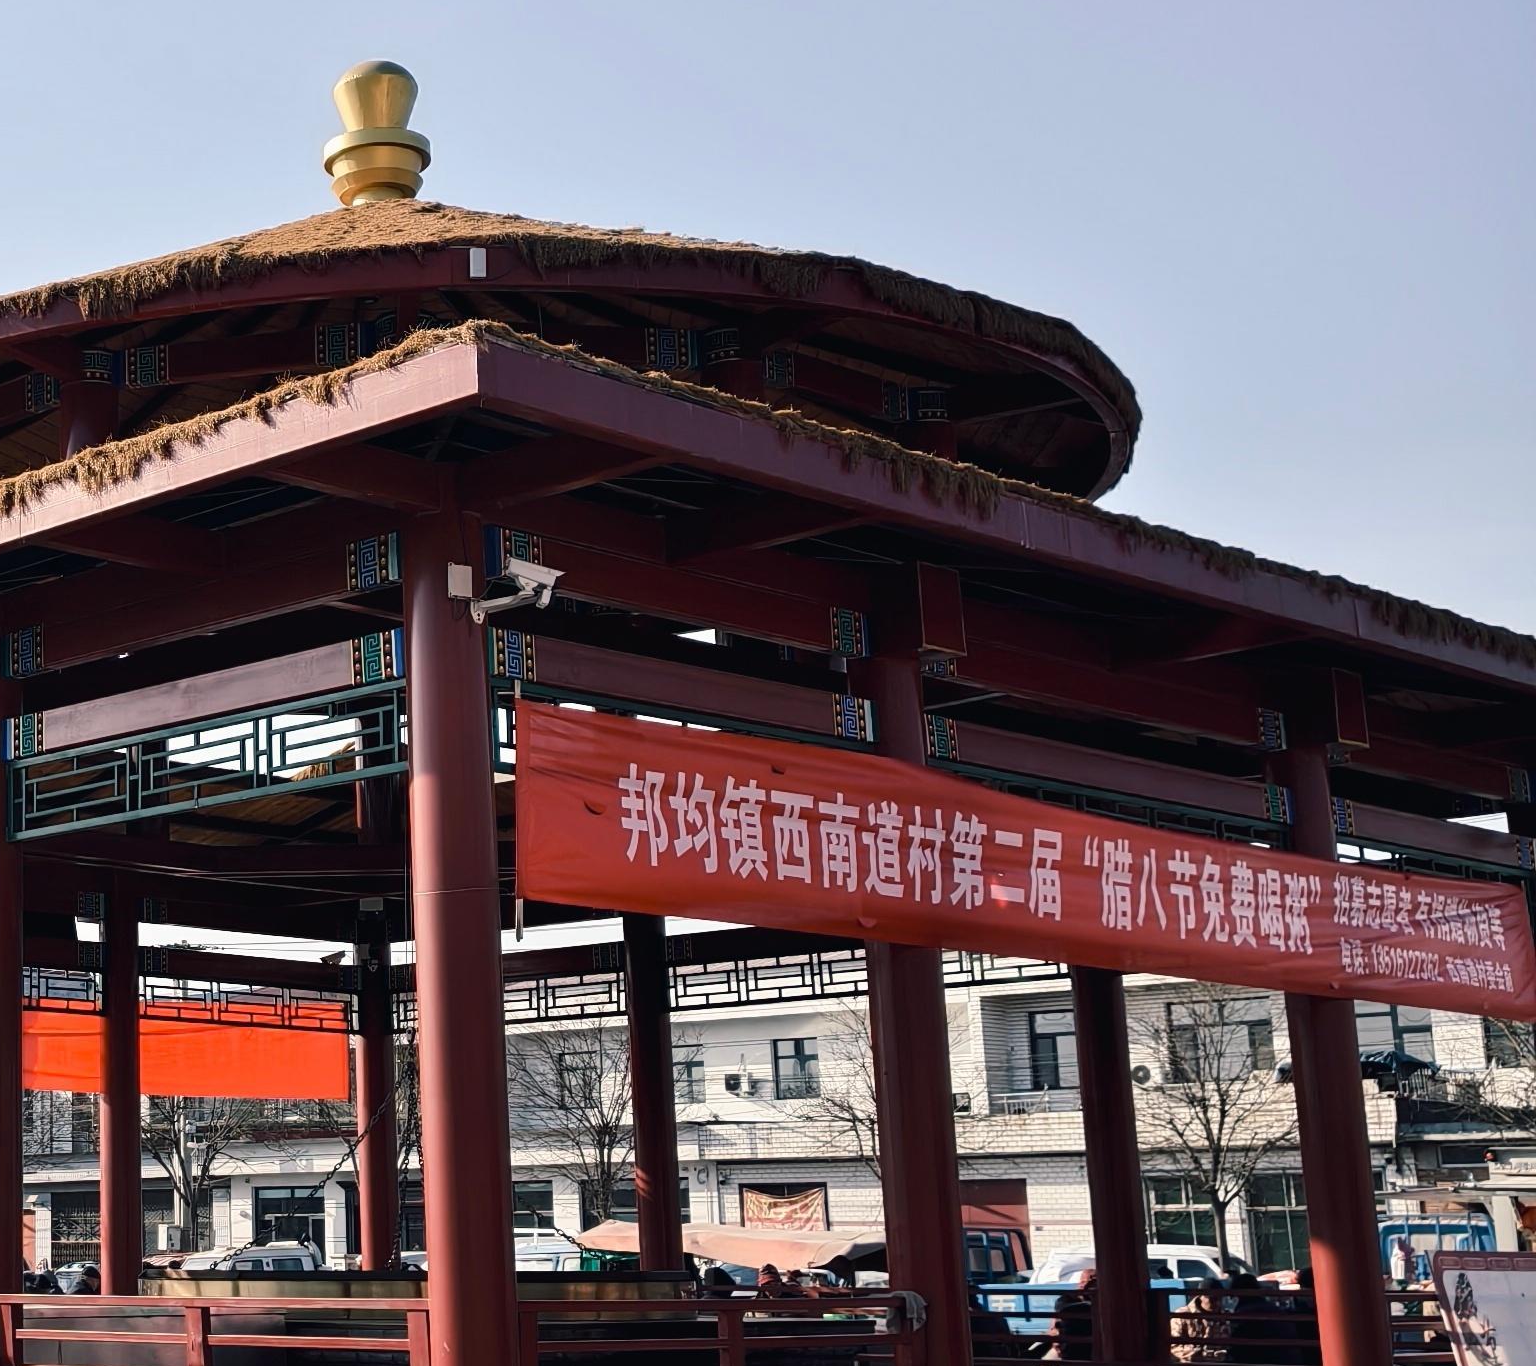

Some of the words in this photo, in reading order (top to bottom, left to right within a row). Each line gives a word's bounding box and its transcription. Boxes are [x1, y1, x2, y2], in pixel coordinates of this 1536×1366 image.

[1332, 872, 1415, 936] 招募志愿者
